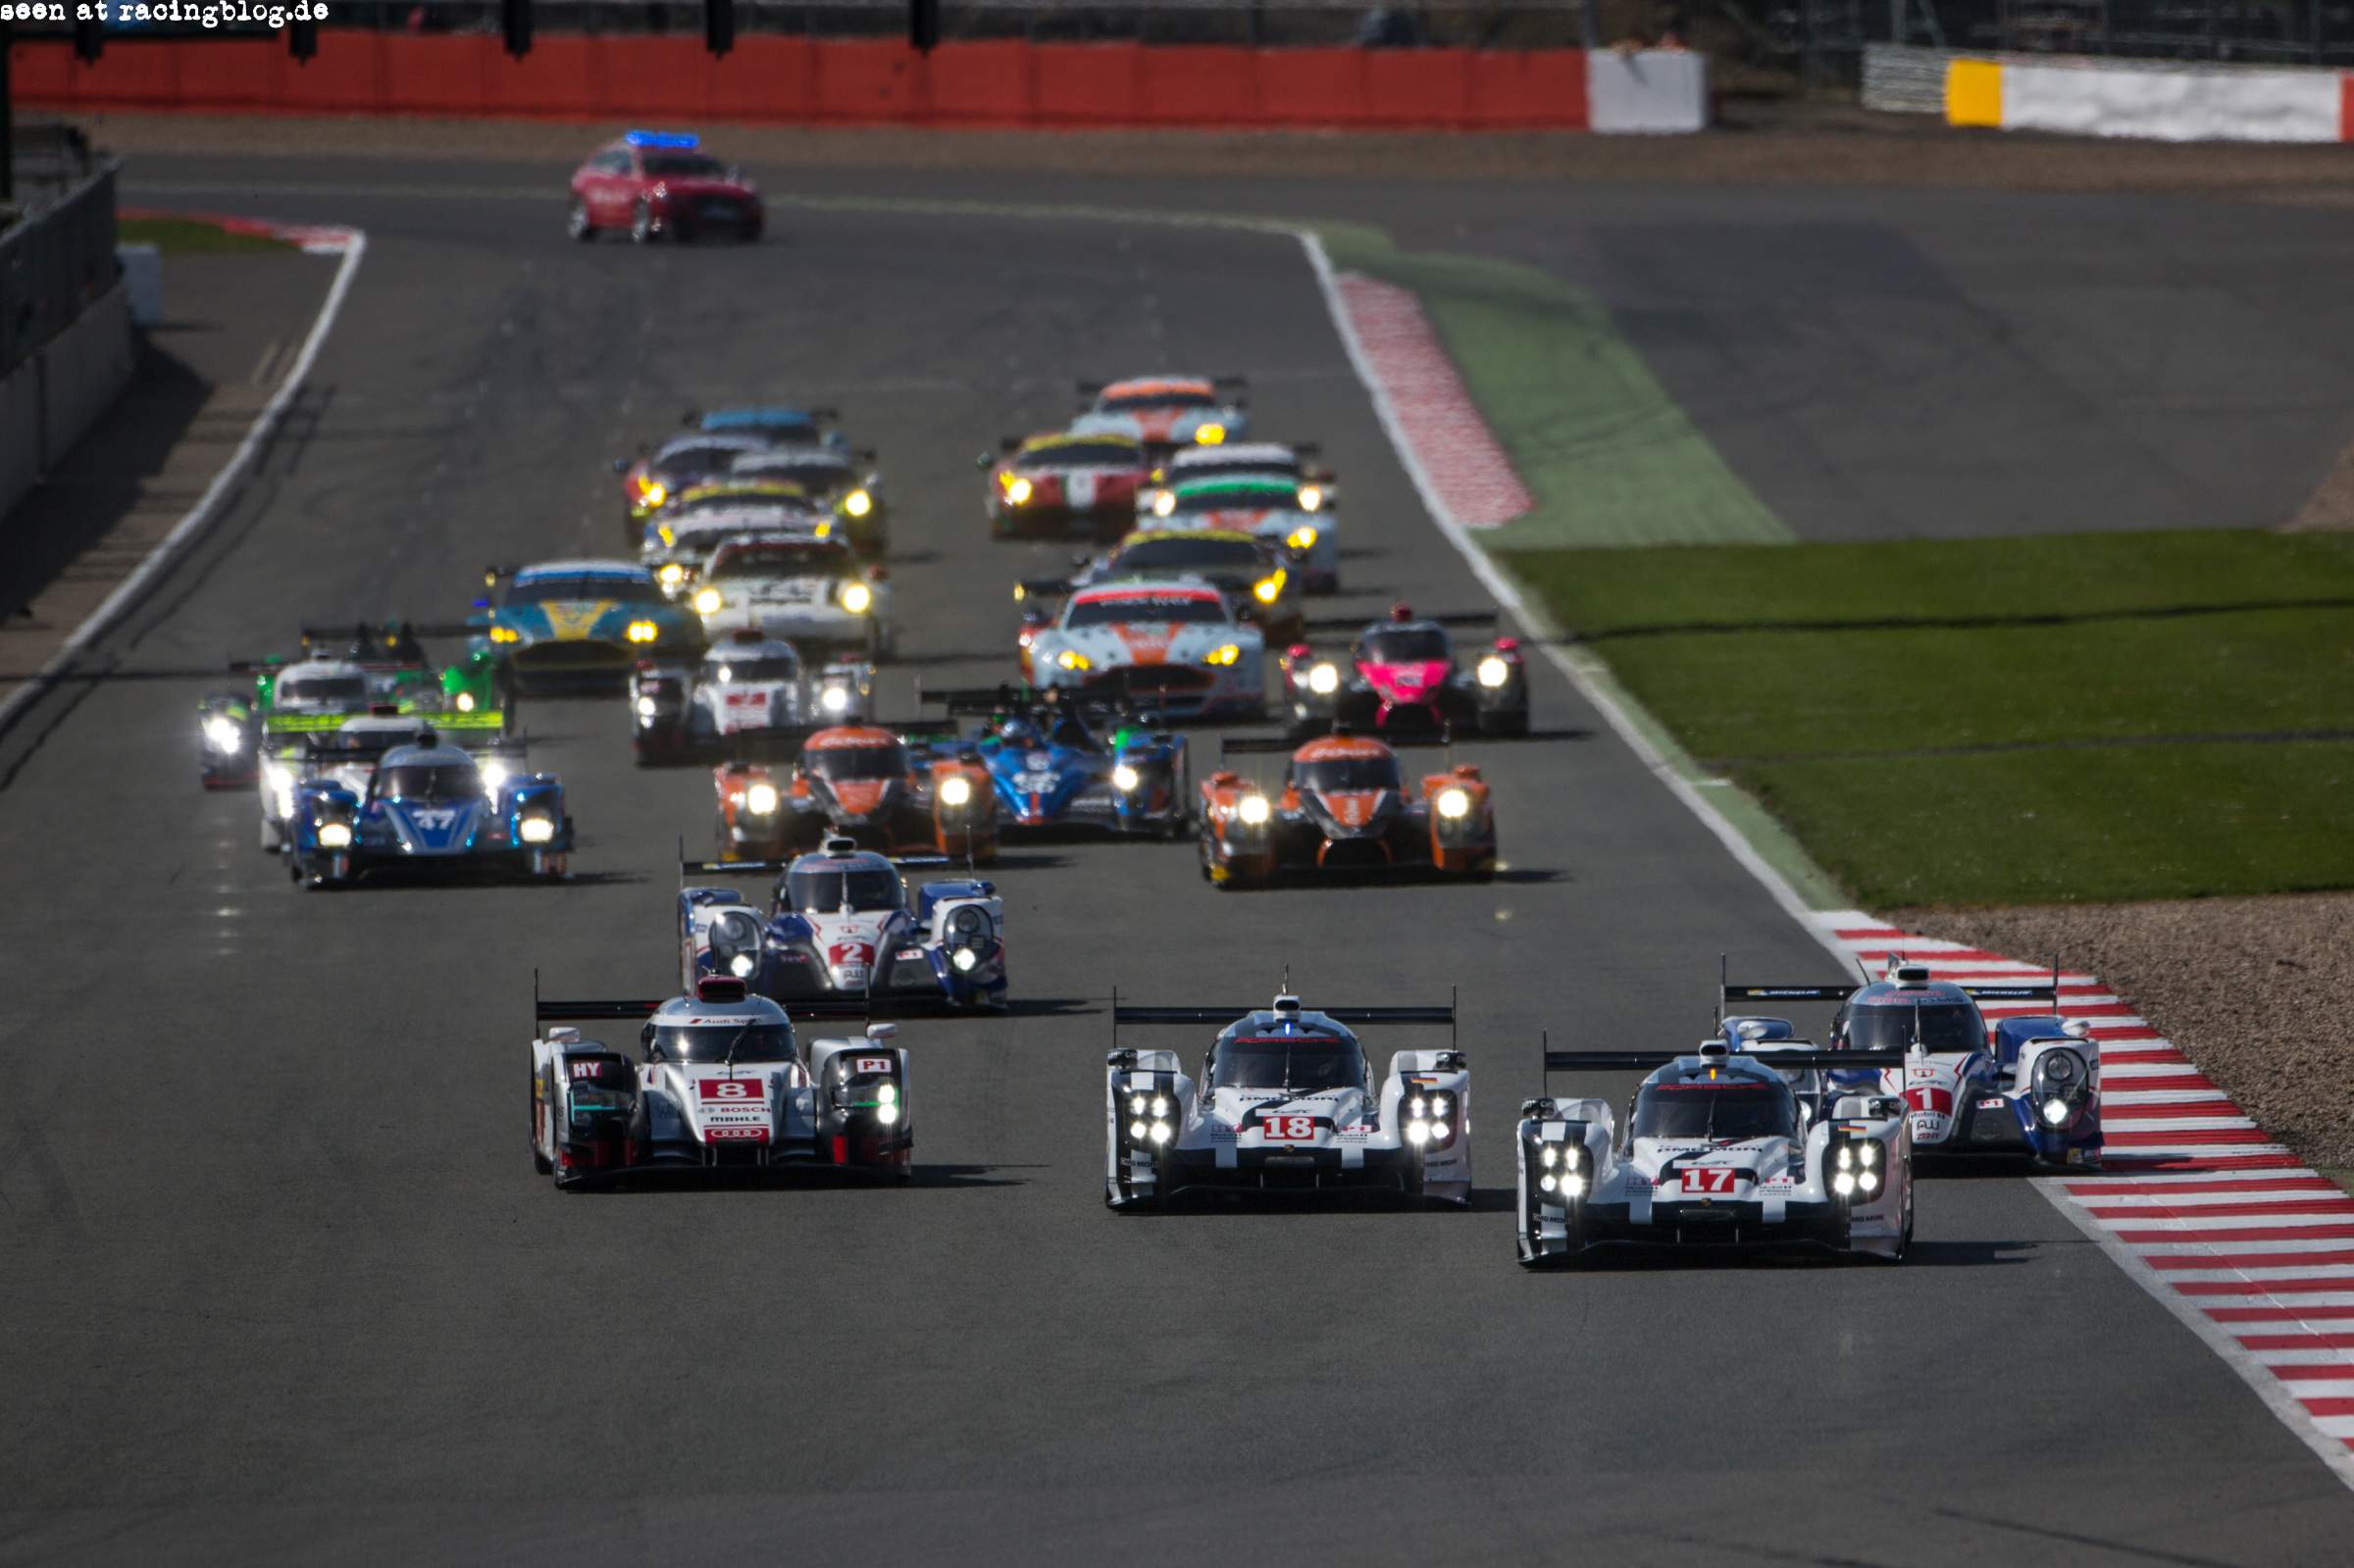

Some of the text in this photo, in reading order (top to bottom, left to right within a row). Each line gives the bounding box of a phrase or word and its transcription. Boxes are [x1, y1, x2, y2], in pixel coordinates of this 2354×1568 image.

[841, 943, 863, 962] 2
[573, 1061, 600, 1078] HY
[863, 1061, 886, 1070] P1
[717, 1082, 747, 1098] 8
[1915, 1087, 1932, 1110] 1
[1265, 1117, 1311, 1138] 18
[1685, 1169, 1732, 1191] 17
